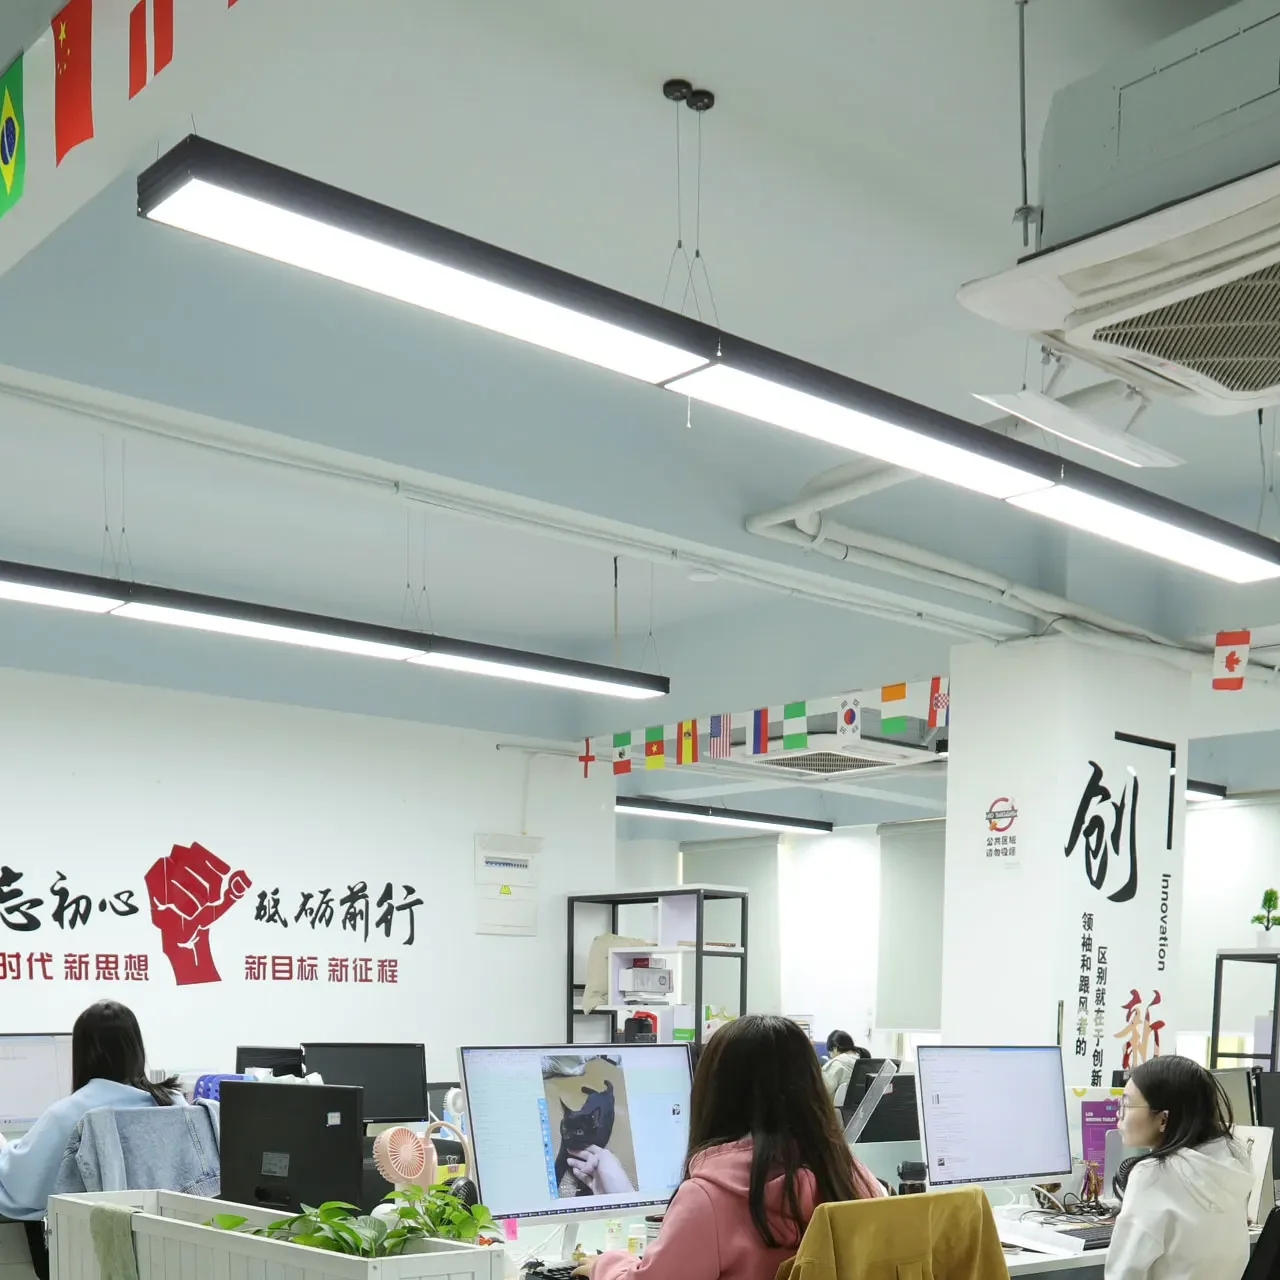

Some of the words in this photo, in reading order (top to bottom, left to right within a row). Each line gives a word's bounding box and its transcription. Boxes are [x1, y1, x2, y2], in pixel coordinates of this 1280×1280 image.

[1064, 760, 1139, 903] 创
[254, 881, 424, 946] 砥砺前行
[1157, 873, 1172, 971] Innovation
[63, 953, 150, 982] 新思想
[244, 955, 320, 981] 新目标
[327, 957, 399, 984] 新征程
[1075, 912, 1094, 1058] 领袖和跟风者的
[1090, 945, 1108, 1088] 区别就在于创新
